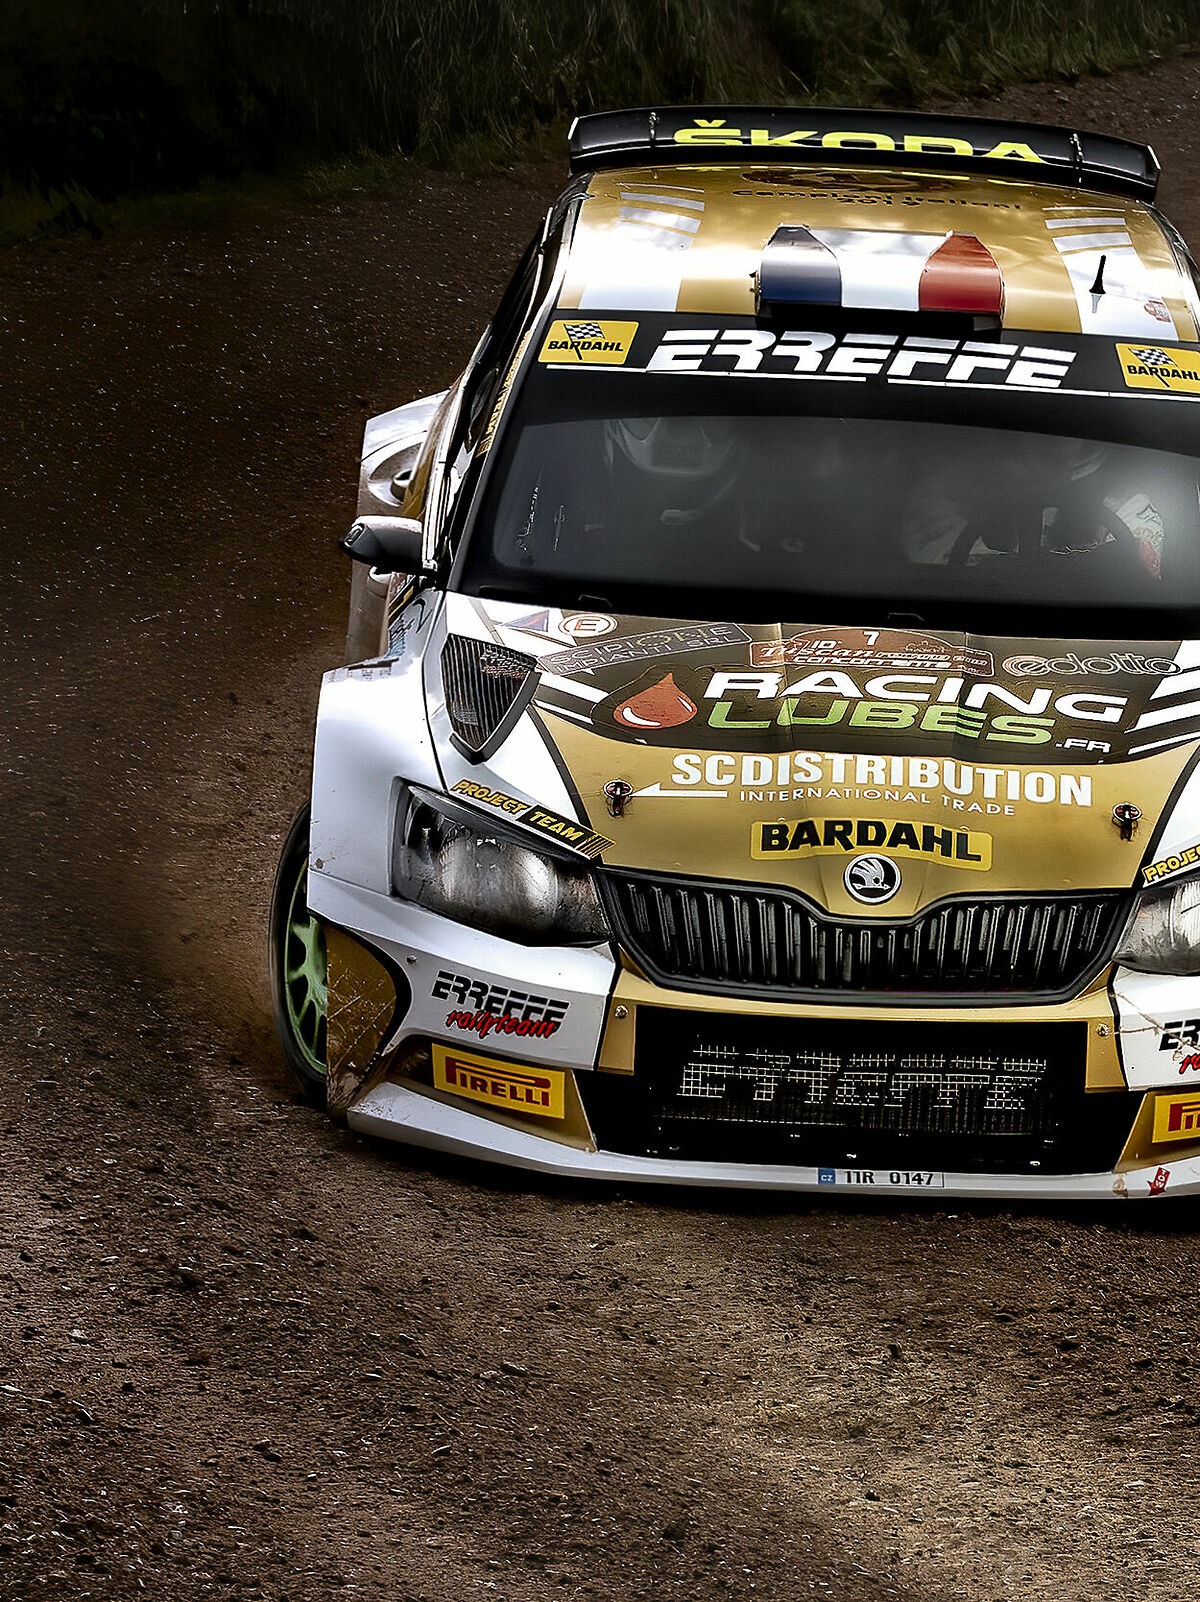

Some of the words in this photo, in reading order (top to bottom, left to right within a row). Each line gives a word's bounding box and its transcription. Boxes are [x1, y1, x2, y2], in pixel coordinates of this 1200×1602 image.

[673, 119, 1051, 164] ŠKODA
[547, 340, 624, 352] BARDAHL
[646, 329, 1077, 388] ERREFFE
[550, 626, 733, 664] SCIPIONE
[556, 644, 672, 672] IMPIANTI
[686, 635, 741, 648] SRL
[863, 631, 880, 647] 7
[703, 671, 1129, 723] RACING
[670, 752, 1092, 807] SCDISTRIBUTION
[451, 779, 531, 815] PROJECT
[530, 811, 585, 842] TEAM
[739, 790, 931, 804] INTERNATIONAL
[941, 795, 1016, 816] TRADE
[760, 820, 982, 862] BARDAHL
[431, 970, 570, 1027] ERREFFE
[445, 1056, 552, 1107] PIRELLI
[820, 1174, 834, 1182] CZ
[889, 1172, 934, 1185] 0147
